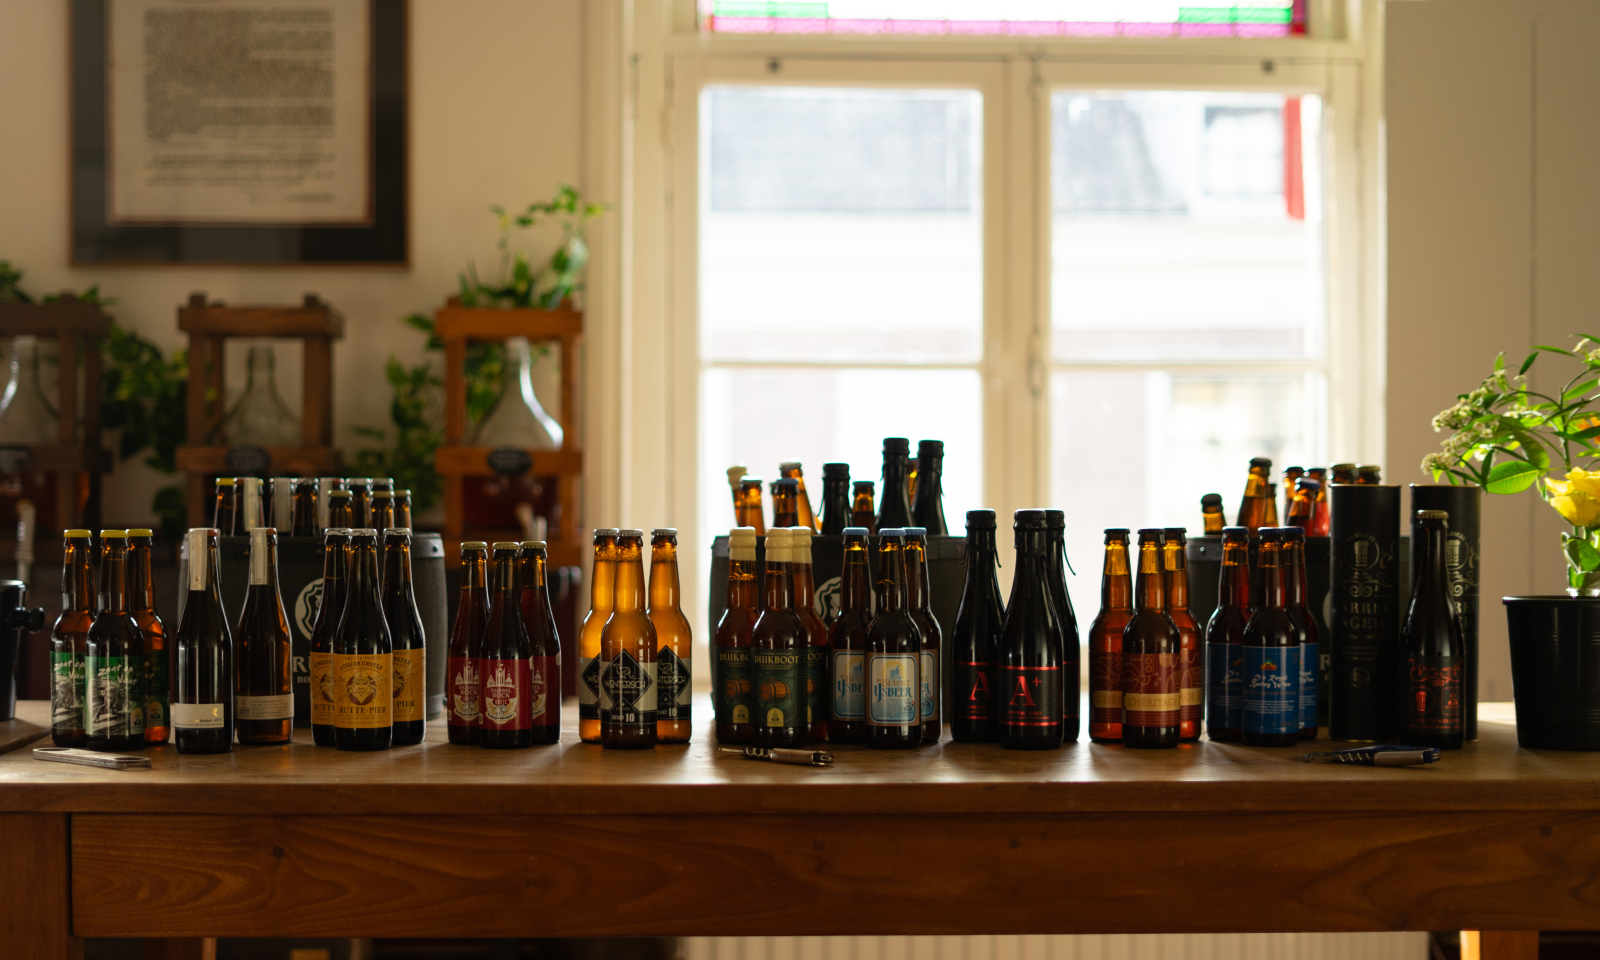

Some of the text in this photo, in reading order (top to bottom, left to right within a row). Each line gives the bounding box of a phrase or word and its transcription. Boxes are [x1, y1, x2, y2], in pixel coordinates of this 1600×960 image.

[754, 655, 800, 664] DUIKBOOT
[123, 666, 134, 675] op
[668, 707, 677, 717] 10
[625, 713, 635, 723] 10
